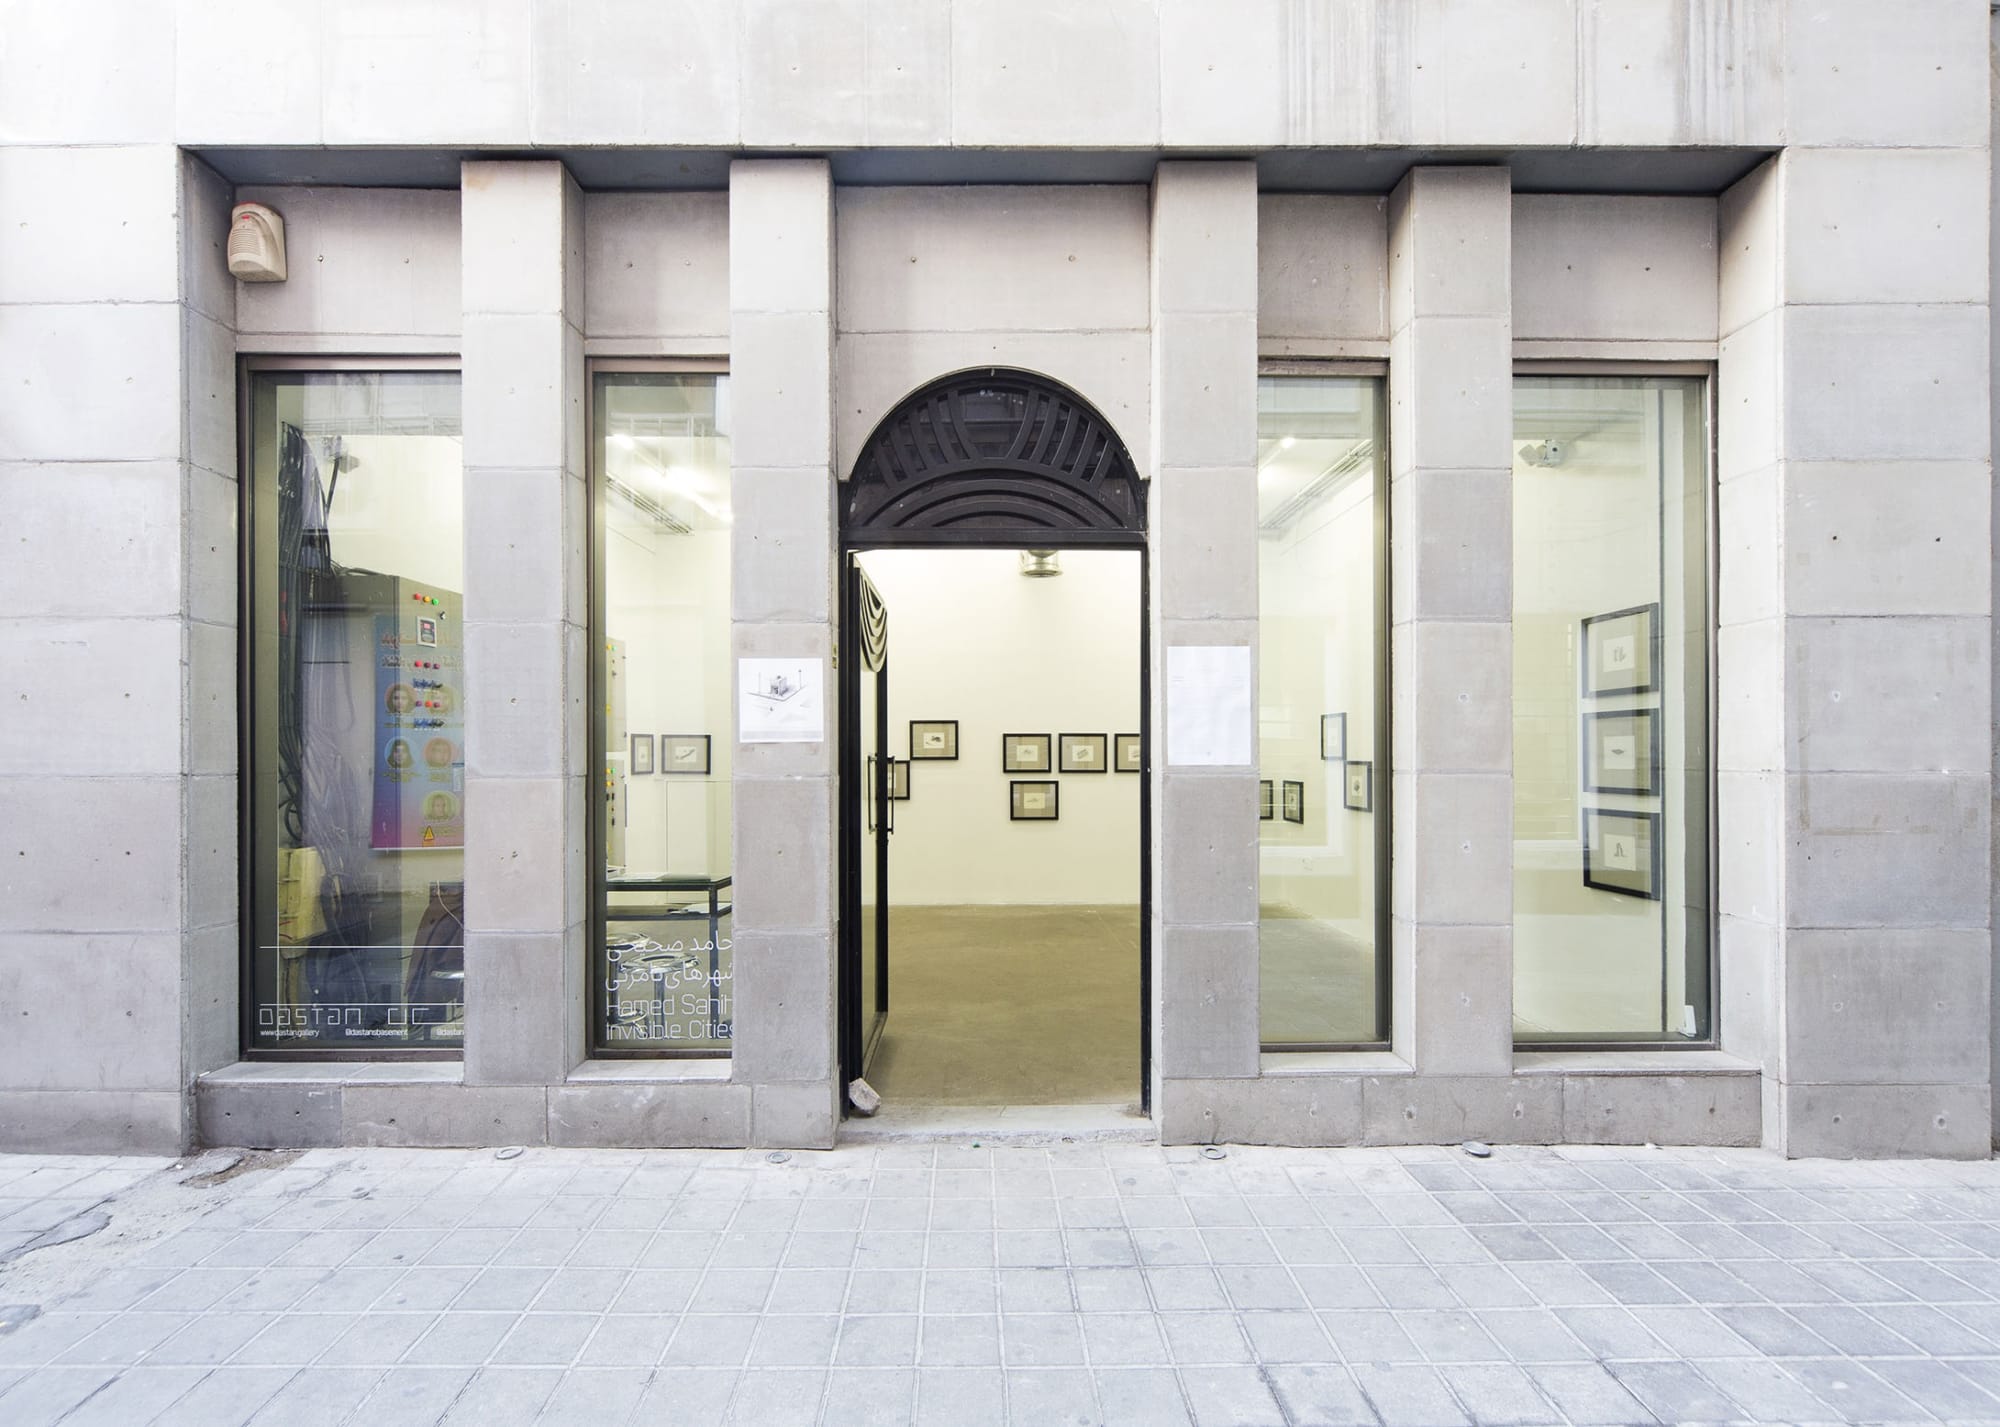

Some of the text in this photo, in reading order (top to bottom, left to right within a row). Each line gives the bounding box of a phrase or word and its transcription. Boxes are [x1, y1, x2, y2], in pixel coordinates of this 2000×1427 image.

[690, 930, 733, 952] حامد
[606, 994, 675, 1017] Hamed
[606, 1020, 682, 1041] Invisible
